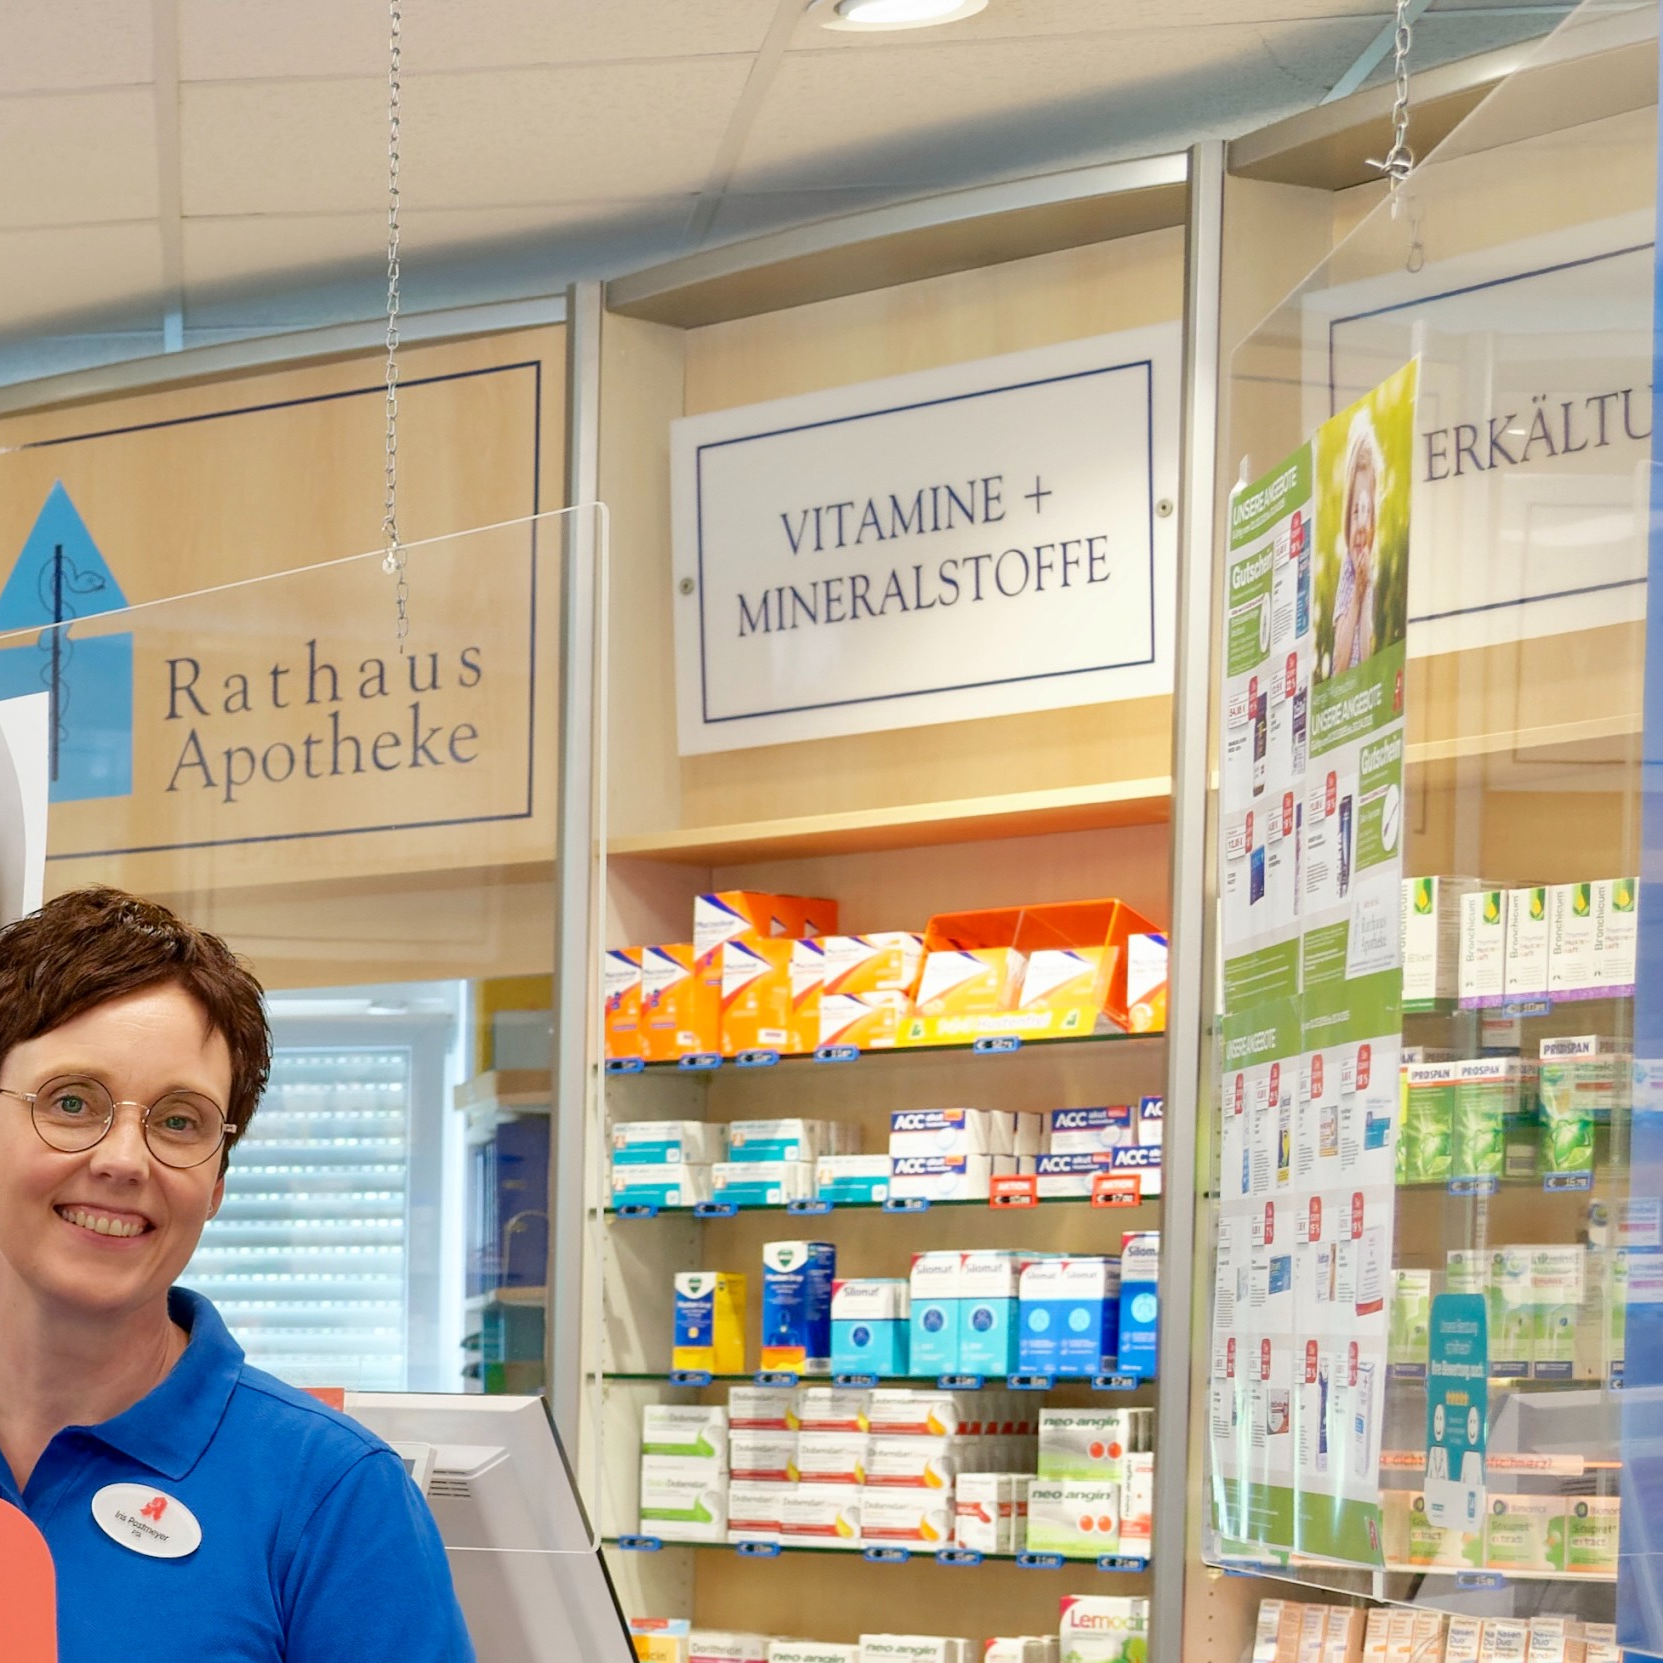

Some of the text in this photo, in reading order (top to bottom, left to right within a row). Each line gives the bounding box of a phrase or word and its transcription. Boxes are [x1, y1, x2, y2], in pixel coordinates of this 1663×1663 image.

[780, 474, 1054, 559] VITAMINE +
[735, 535, 1113, 639] MINERALSTOFFE
[164, 638, 485, 721] Rathaus
[164, 701, 482, 804] Apotheke
